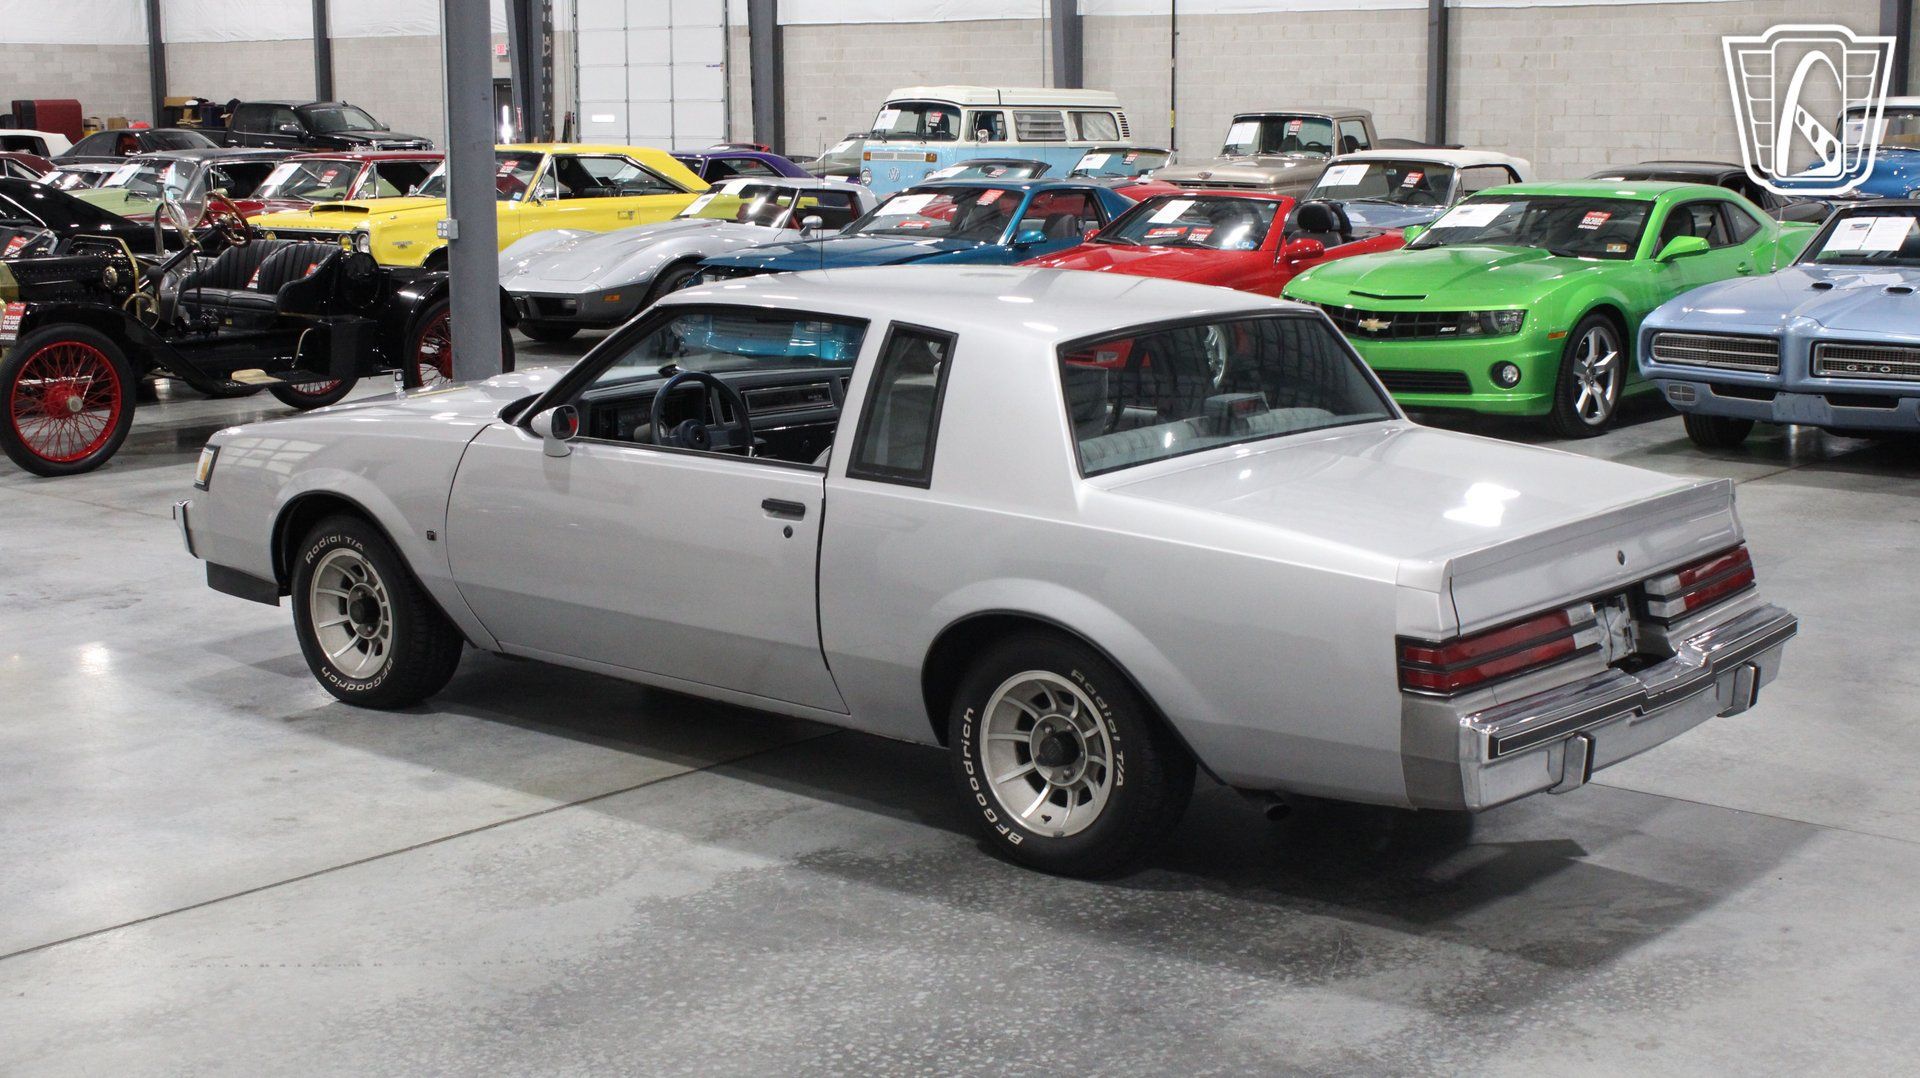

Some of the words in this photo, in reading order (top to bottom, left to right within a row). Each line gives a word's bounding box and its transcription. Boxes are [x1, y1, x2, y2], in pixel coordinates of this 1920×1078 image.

[1846, 364, 1891, 373] GTO
[305, 534, 341, 564] Radial
[344, 536, 364, 552] T/A
[321, 657, 393, 691] BFGoodrich
[1070, 669, 1121, 742] Radial
[1116, 750, 1125, 787] T/A
[962, 707, 1024, 845] BFGoodrich
